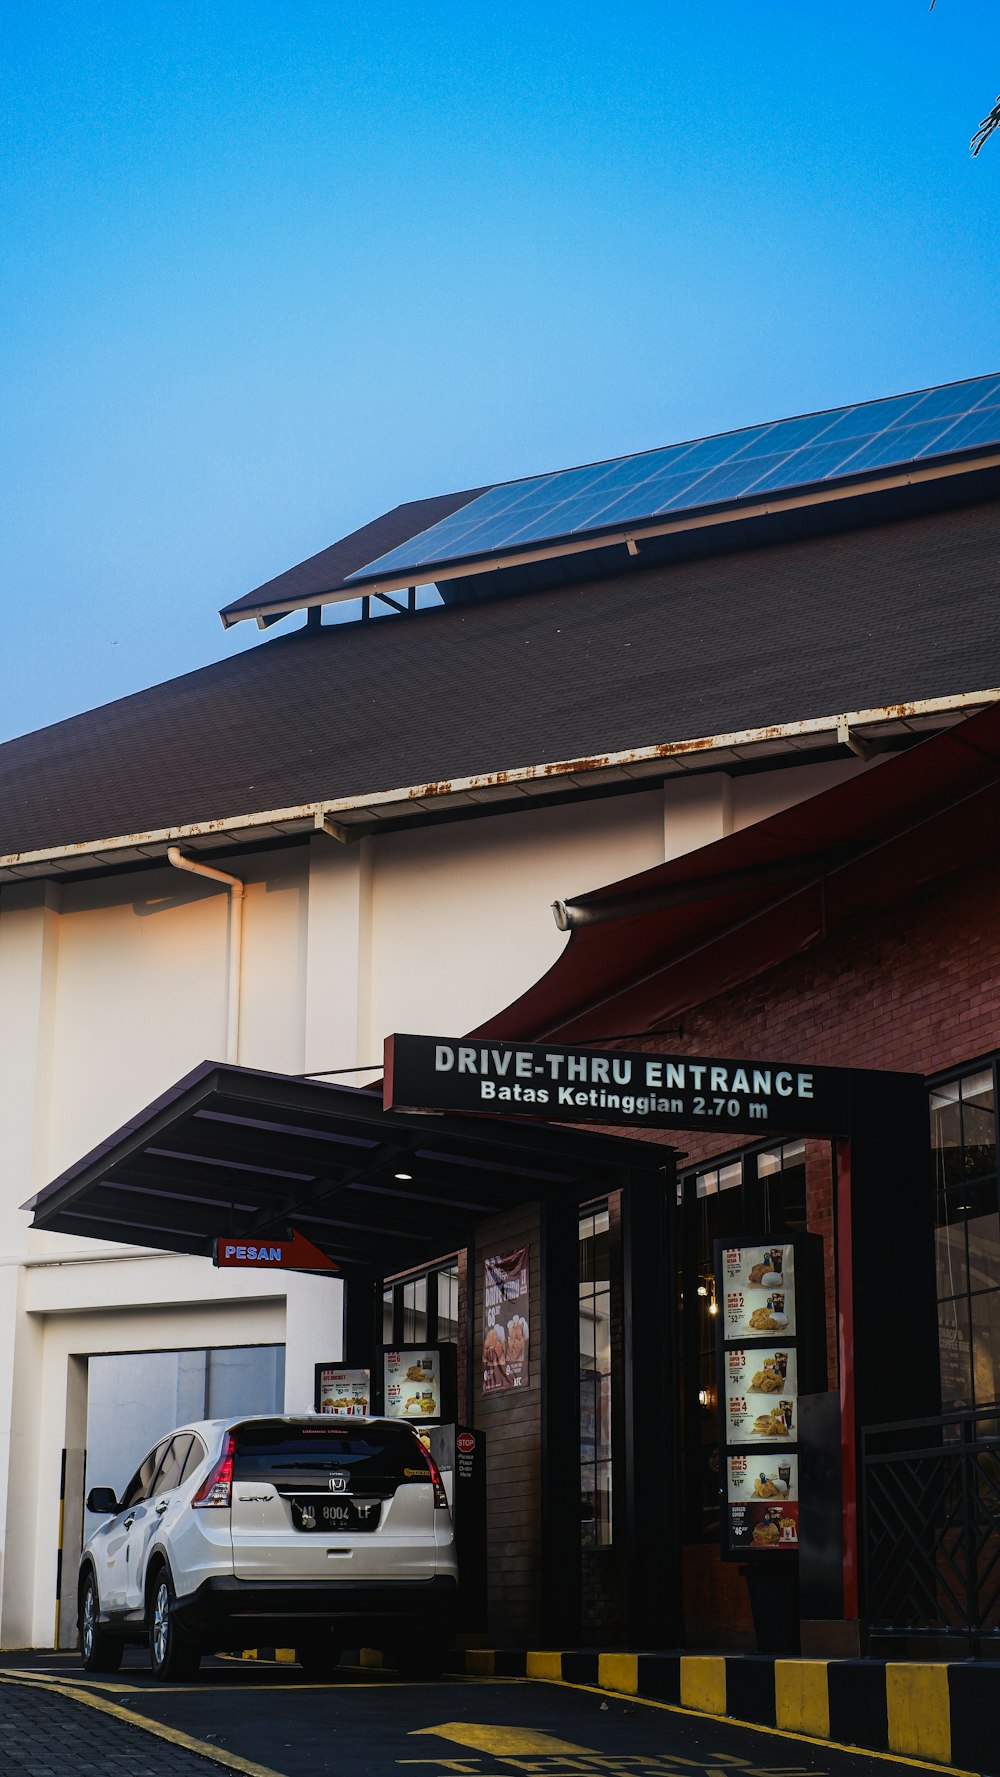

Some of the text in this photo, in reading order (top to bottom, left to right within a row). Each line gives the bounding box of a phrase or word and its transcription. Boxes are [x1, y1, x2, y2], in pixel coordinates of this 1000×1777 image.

[435, 1045, 814, 1098] DRIVE-THRU ENTRANCE
[480, 1080, 768, 1119] Batas Ketinggian 2.70 m
[225, 1245, 281, 1261] PESAN
[323, 1506, 349, 1519] 8004
[394, 1752, 754, 1773] THRU
